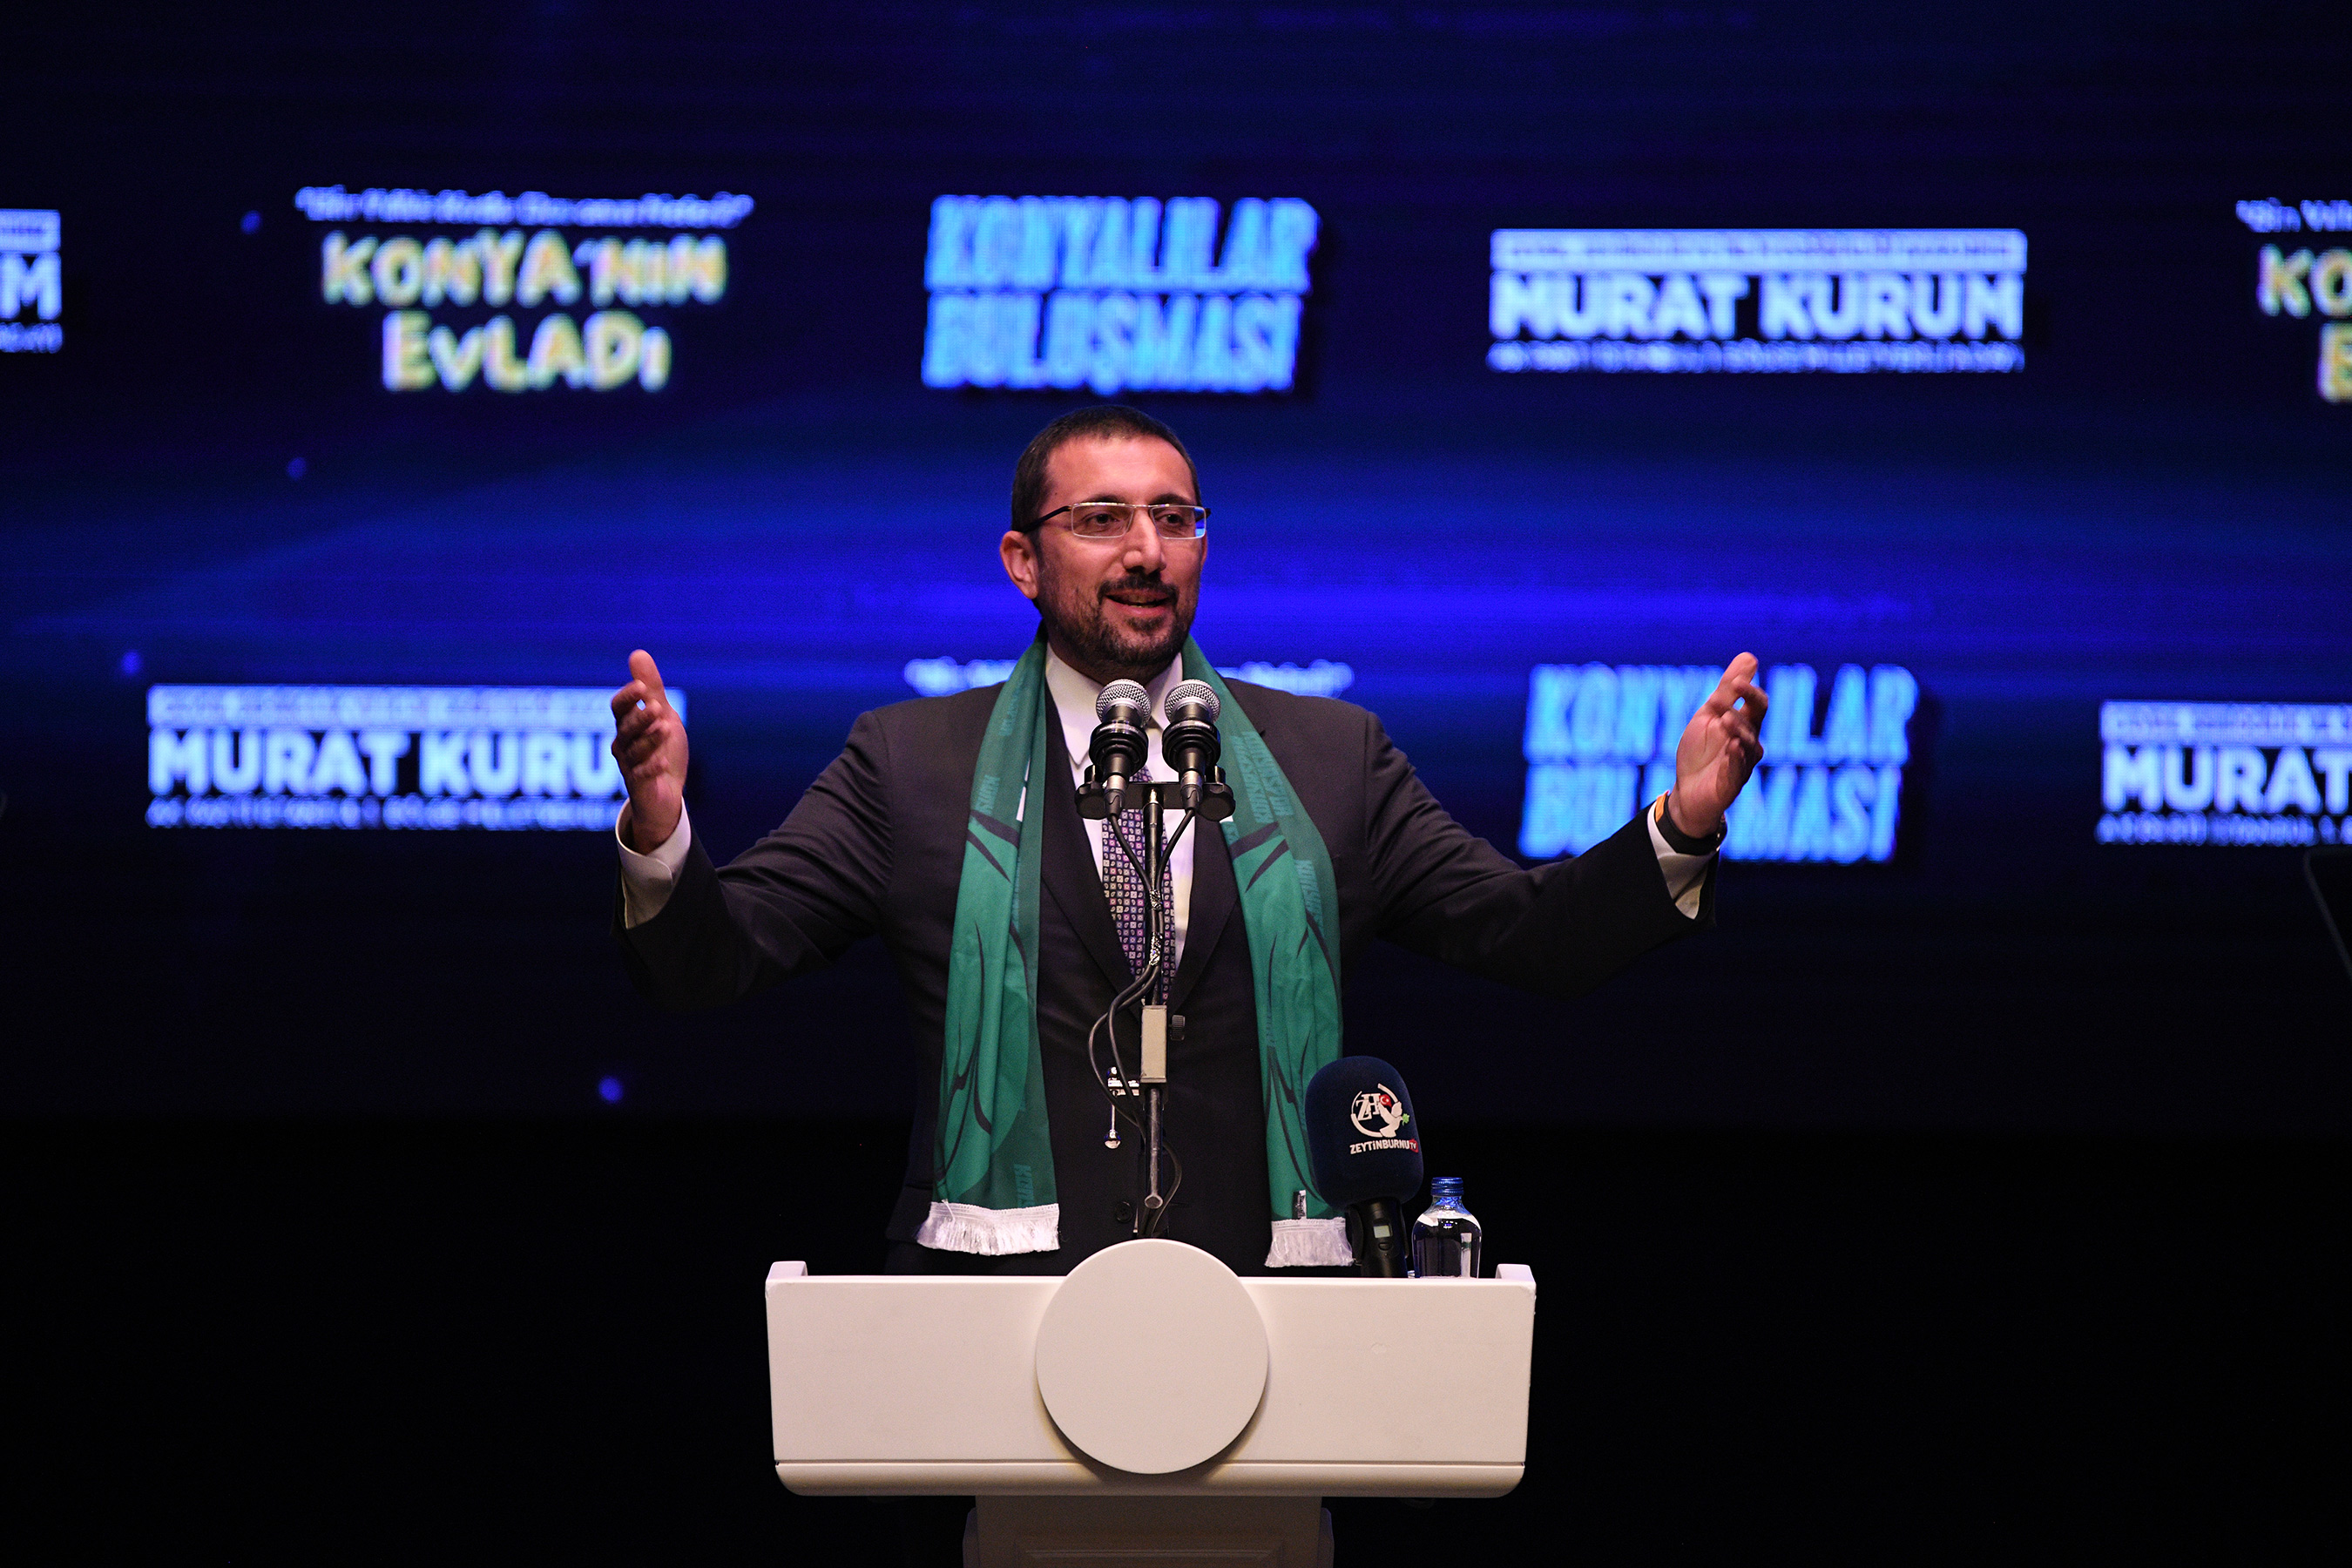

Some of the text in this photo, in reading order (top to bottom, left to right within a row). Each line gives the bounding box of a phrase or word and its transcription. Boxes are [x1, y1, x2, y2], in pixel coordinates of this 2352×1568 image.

[924, 194, 1321, 294] KONYALILAR
[1490, 270, 2024, 340] MURAT KURUM
[147, 727, 629, 798] MURAT KURU
[2101, 743, 2352, 814] MURAT
